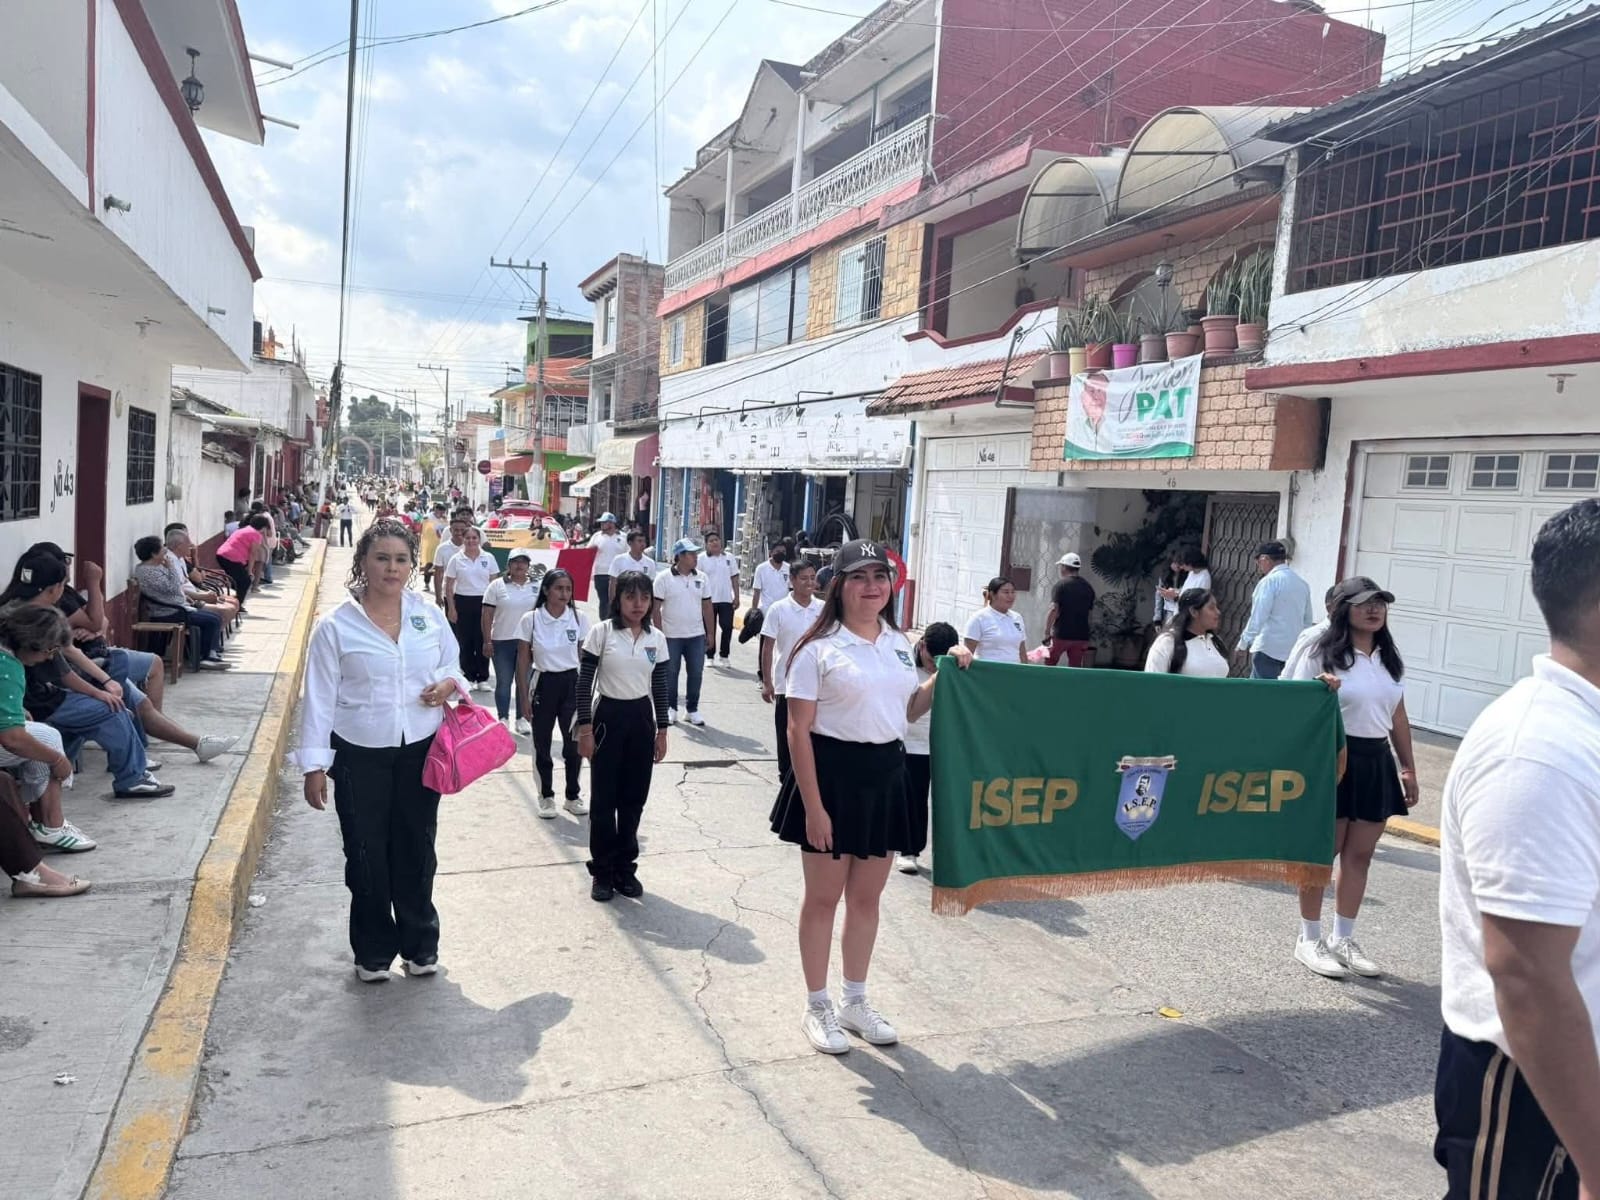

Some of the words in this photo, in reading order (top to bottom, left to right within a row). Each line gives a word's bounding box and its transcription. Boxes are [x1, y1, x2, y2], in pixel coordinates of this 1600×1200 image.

[1136, 387, 1192, 422] PAT
[63, 464, 74, 497] 43
[861, 543, 877, 557] NY
[969, 777, 1078, 829] ISEP
[1197, 770, 1306, 815] ISEP
